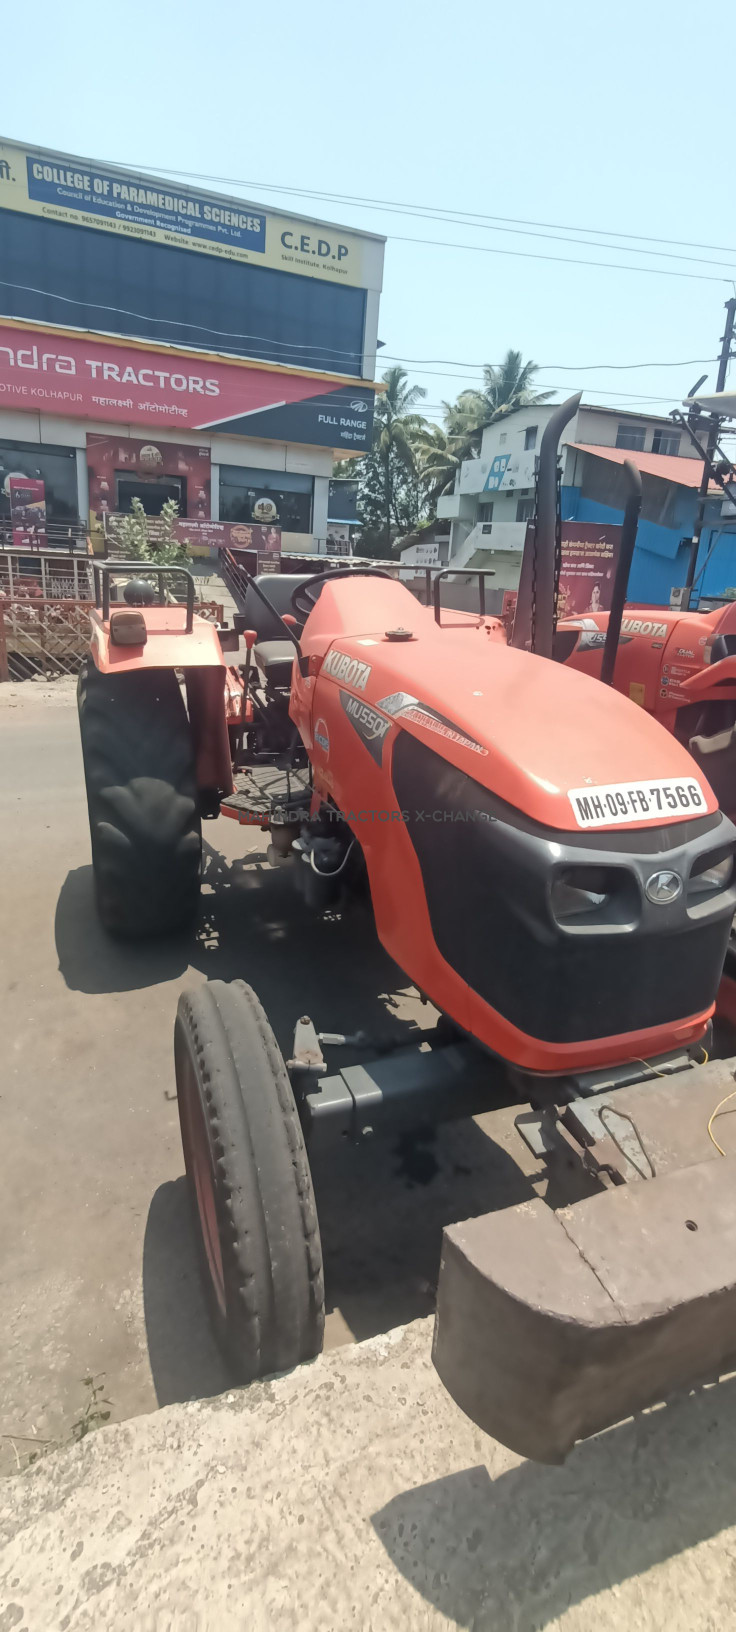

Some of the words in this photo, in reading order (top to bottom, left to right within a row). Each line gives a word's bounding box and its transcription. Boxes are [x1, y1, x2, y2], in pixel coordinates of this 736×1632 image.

[32, 163, 91, 192] COLLEGE
[93, 178, 110, 196] OF
[112, 182, 201, 218] PARAMEDICAL
[203, 205, 261, 233] SCIENCES
[56, 187, 83, 201] Council
[84, 193, 91, 201] of
[92, 195, 126, 210] Education
[126, 203, 132, 212] &
[133, 205, 177, 223] Development
[177, 216, 217, 232] Programmes
[217, 225, 229, 235] Pvt.
[42, 206, 68, 219] Contact
[117, 222, 122, 231] /
[191, 241, 249, 259] www.cedp-edu.com
[115, 210, 156, 226] Government
[156, 220, 192, 235] Recognised
[280, 231, 349, 261] C.E.D.P
[281, 254, 294, 264] Skill
[322, 263, 349, 276] Kolhapur
[85, 359, 220, 397] TRACTORS
[30, 387, 83, 403] KOLHAPUR
[91, 396, 133, 409] महालक्ष्मी
[318, 414, 338, 425] FULL
[339, 417, 367, 430] RANGE
[322, 649, 372, 692] KUBOTA
